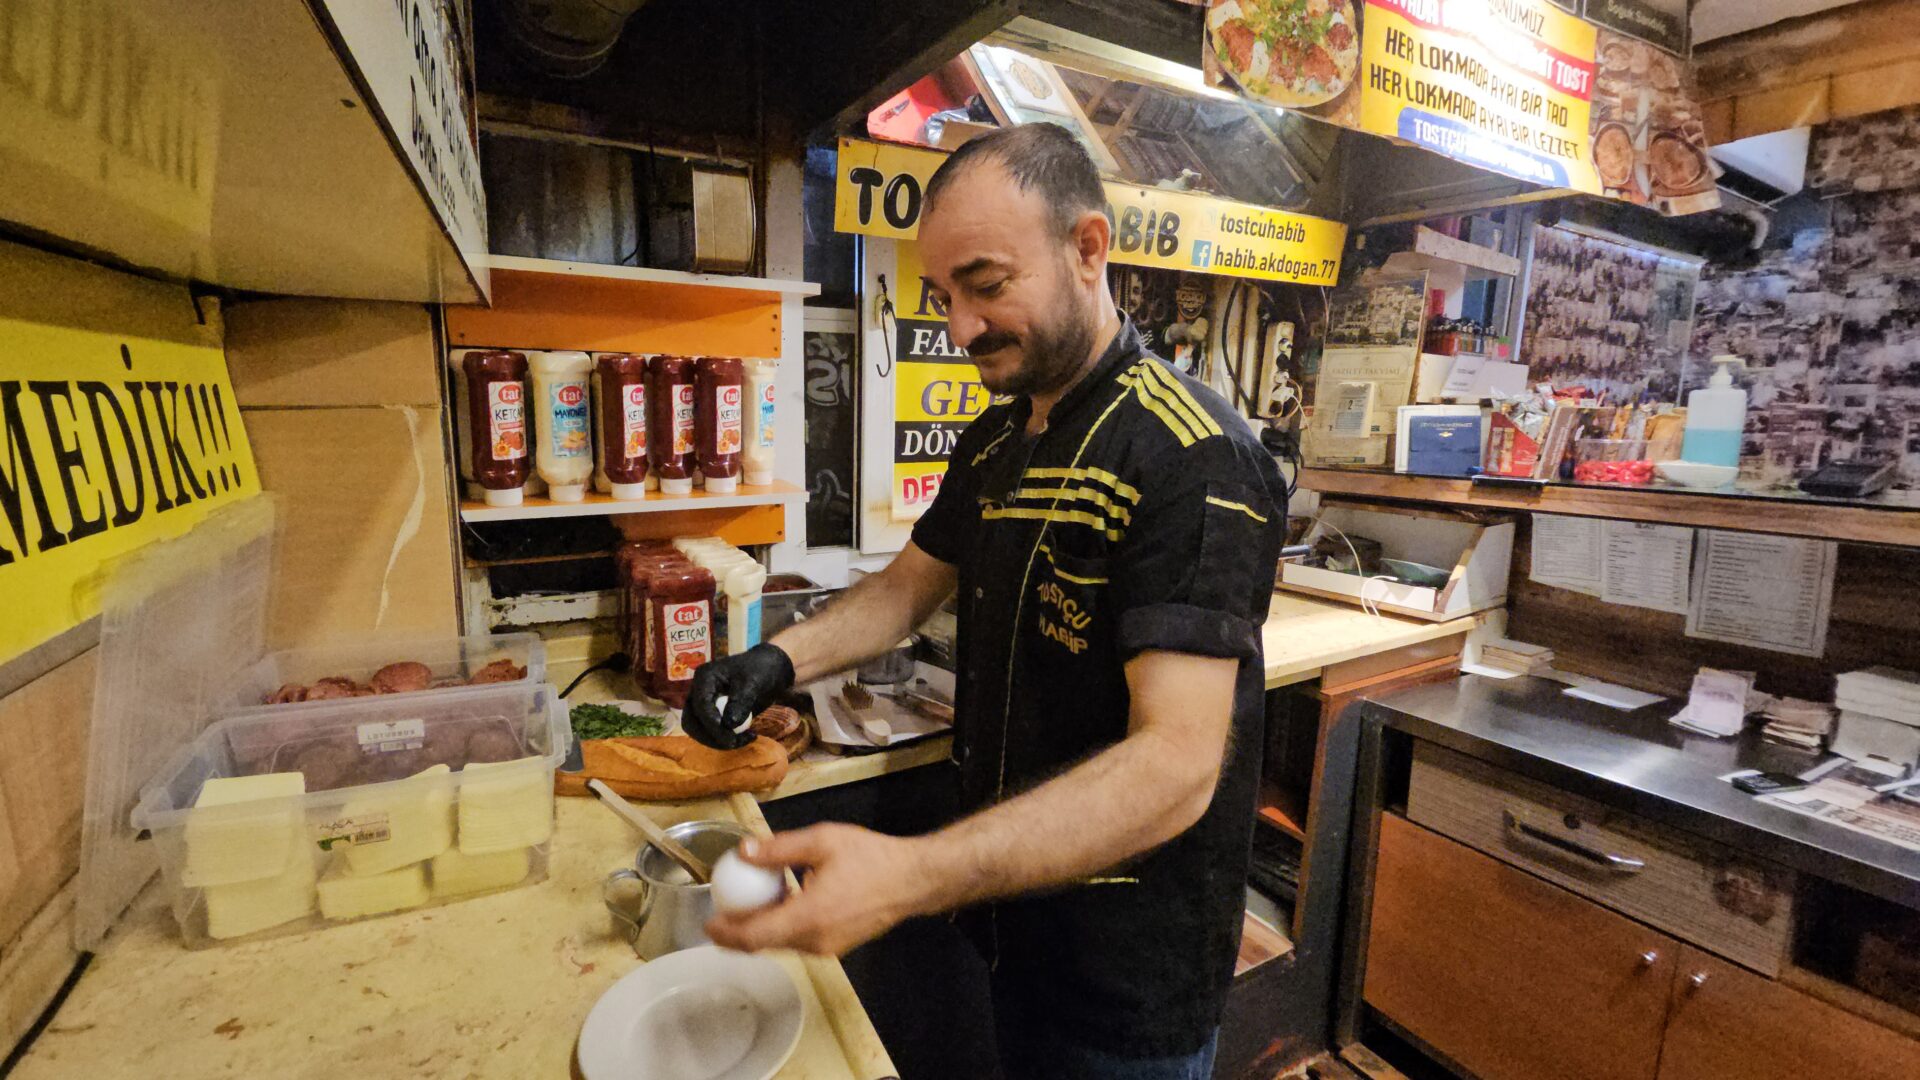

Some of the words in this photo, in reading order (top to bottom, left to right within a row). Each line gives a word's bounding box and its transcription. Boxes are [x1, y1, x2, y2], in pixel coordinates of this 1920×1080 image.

[1385, 26, 1414, 64] HER
[1420, 42, 1488, 92] LOKMADA
[1491, 74, 1519, 109] AYRI
[1521, 87, 1542, 118] BİR
[1546, 99, 1568, 128] TAD
[1556, 60, 1590, 94] TOST
[1370, 63, 1402, 98] HER
[1405, 77, 1476, 125] LOKMADA
[1480, 106, 1508, 138] AYRI
[1533, 129, 1580, 161] LEZZET
[849, 167, 922, 230] TO
[1220, 213, 1306, 243] tostcuhabib
[1214, 245, 1336, 279] habib.akdogan.77
[502, 388, 520, 401] tat
[562, 389, 582, 402] tat
[901, 423, 964, 456] DÖN
[677, 608, 702, 623] tat
[670, 625, 707, 644] KETÇAP
